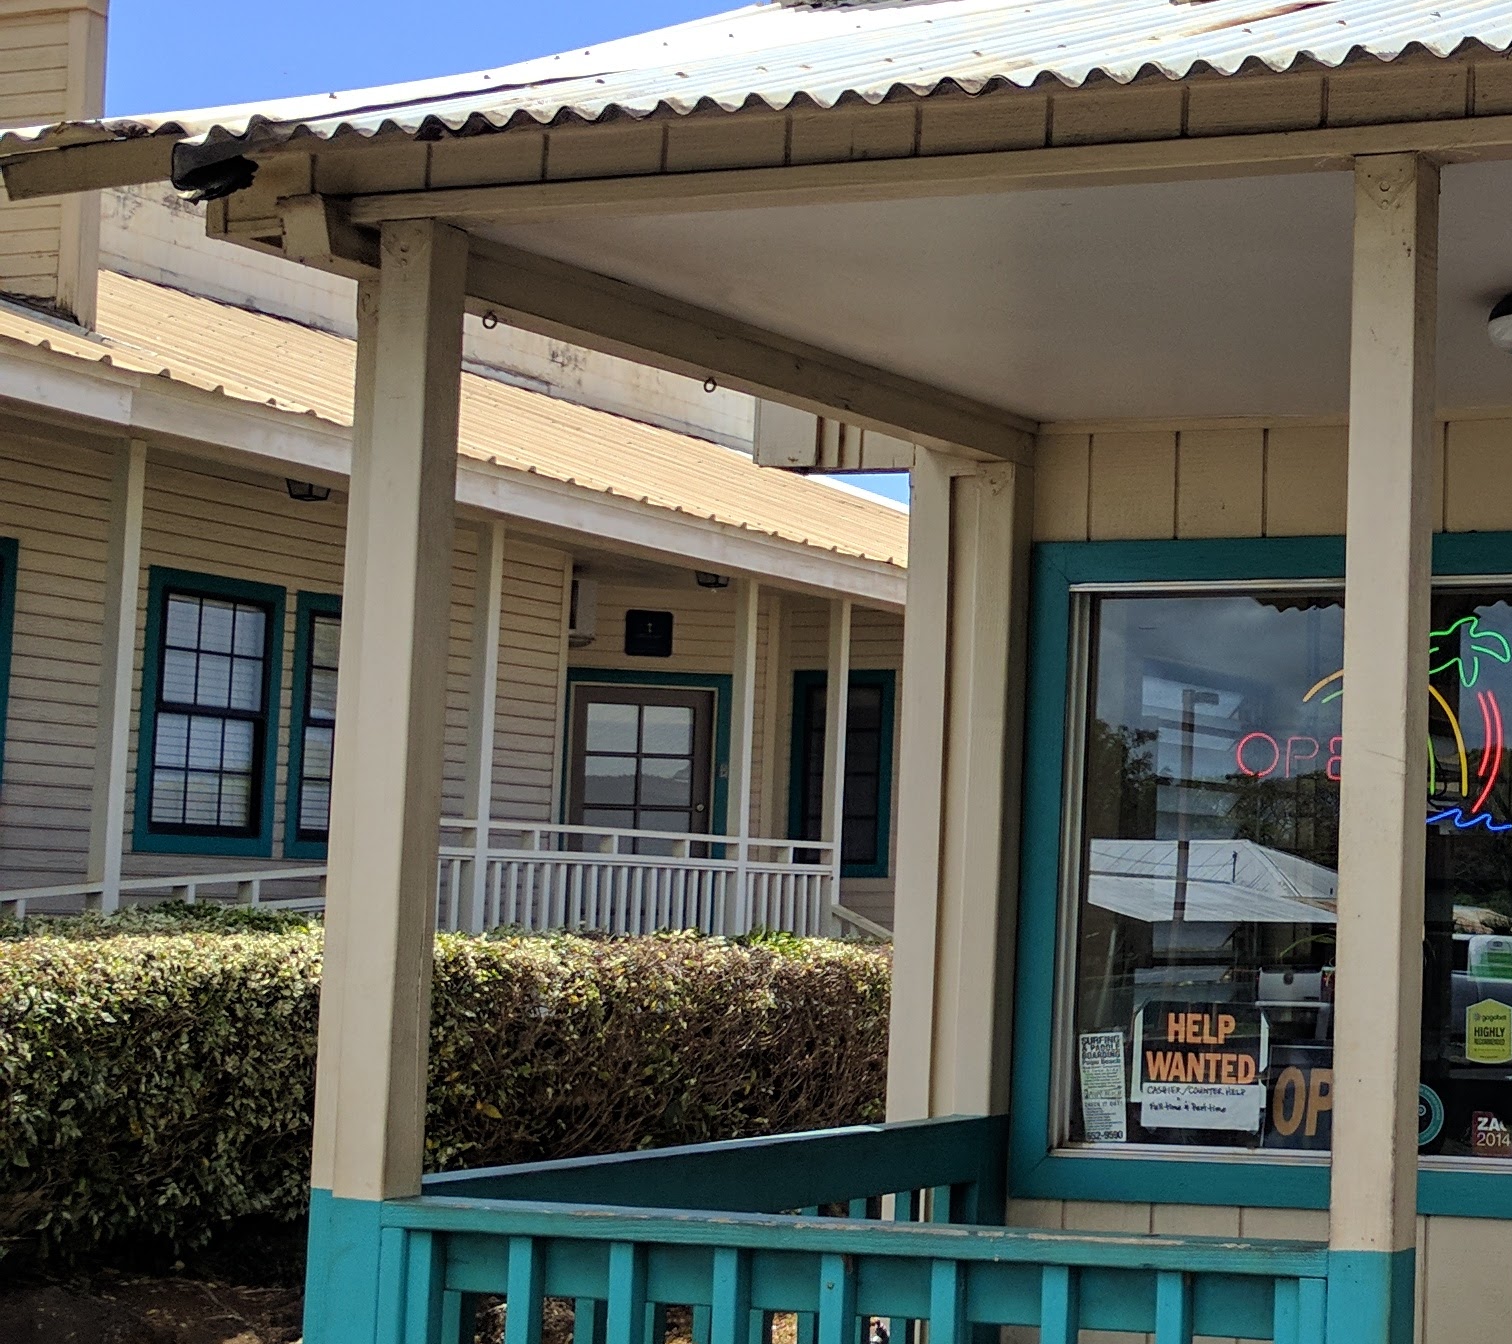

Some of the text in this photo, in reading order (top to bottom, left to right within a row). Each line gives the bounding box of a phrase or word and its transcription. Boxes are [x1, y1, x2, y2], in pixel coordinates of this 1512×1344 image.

[1166, 1012, 1236, 1044] HELP
[1474, 1026, 1506, 1038] HIGHLY
[1146, 1050, 1256, 1085] WANTED
[1476, 1131, 1511, 1147] 2014
